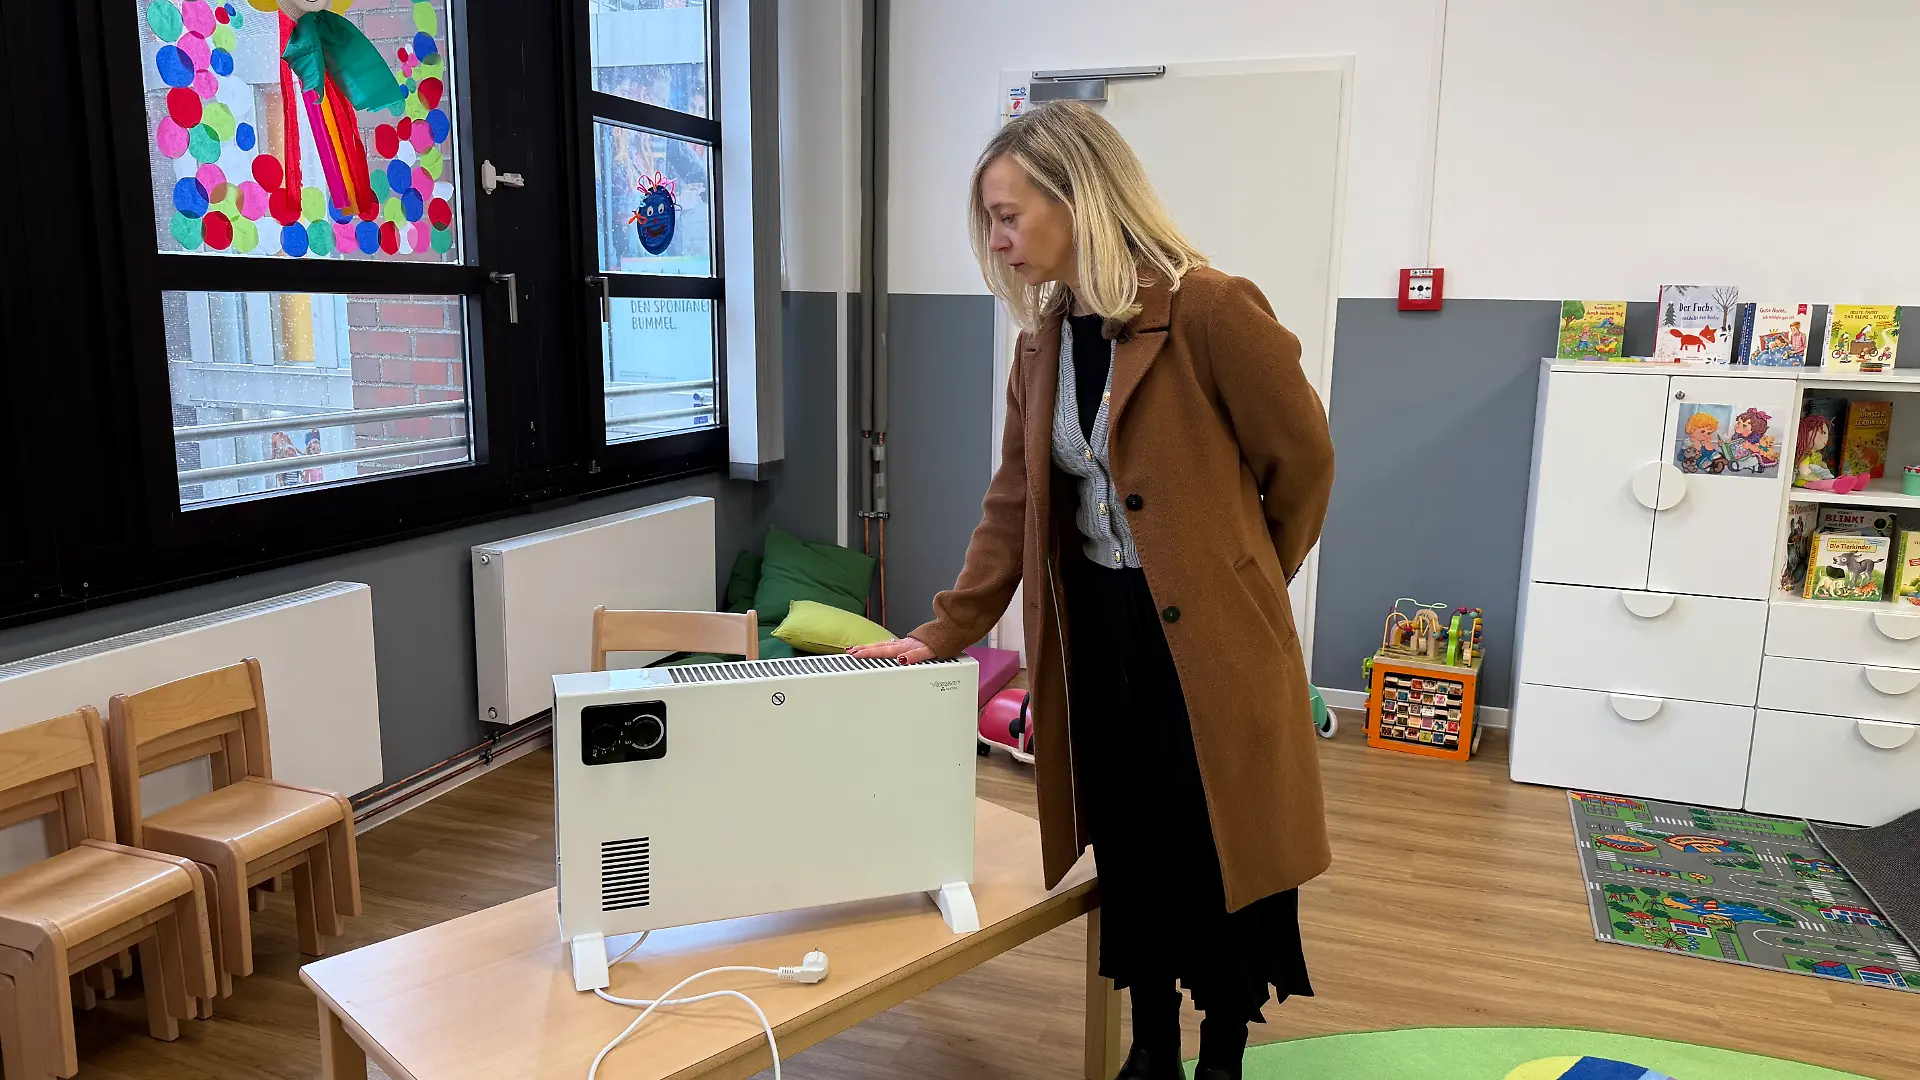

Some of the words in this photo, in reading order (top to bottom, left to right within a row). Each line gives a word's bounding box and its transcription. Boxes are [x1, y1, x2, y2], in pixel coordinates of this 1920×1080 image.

[631, 300, 650, 313] DEN
[1679, 303, 1690, 312] Der
[1693, 303, 1713, 312] Fuchs
[632, 317, 677, 330] BUMMEL.
